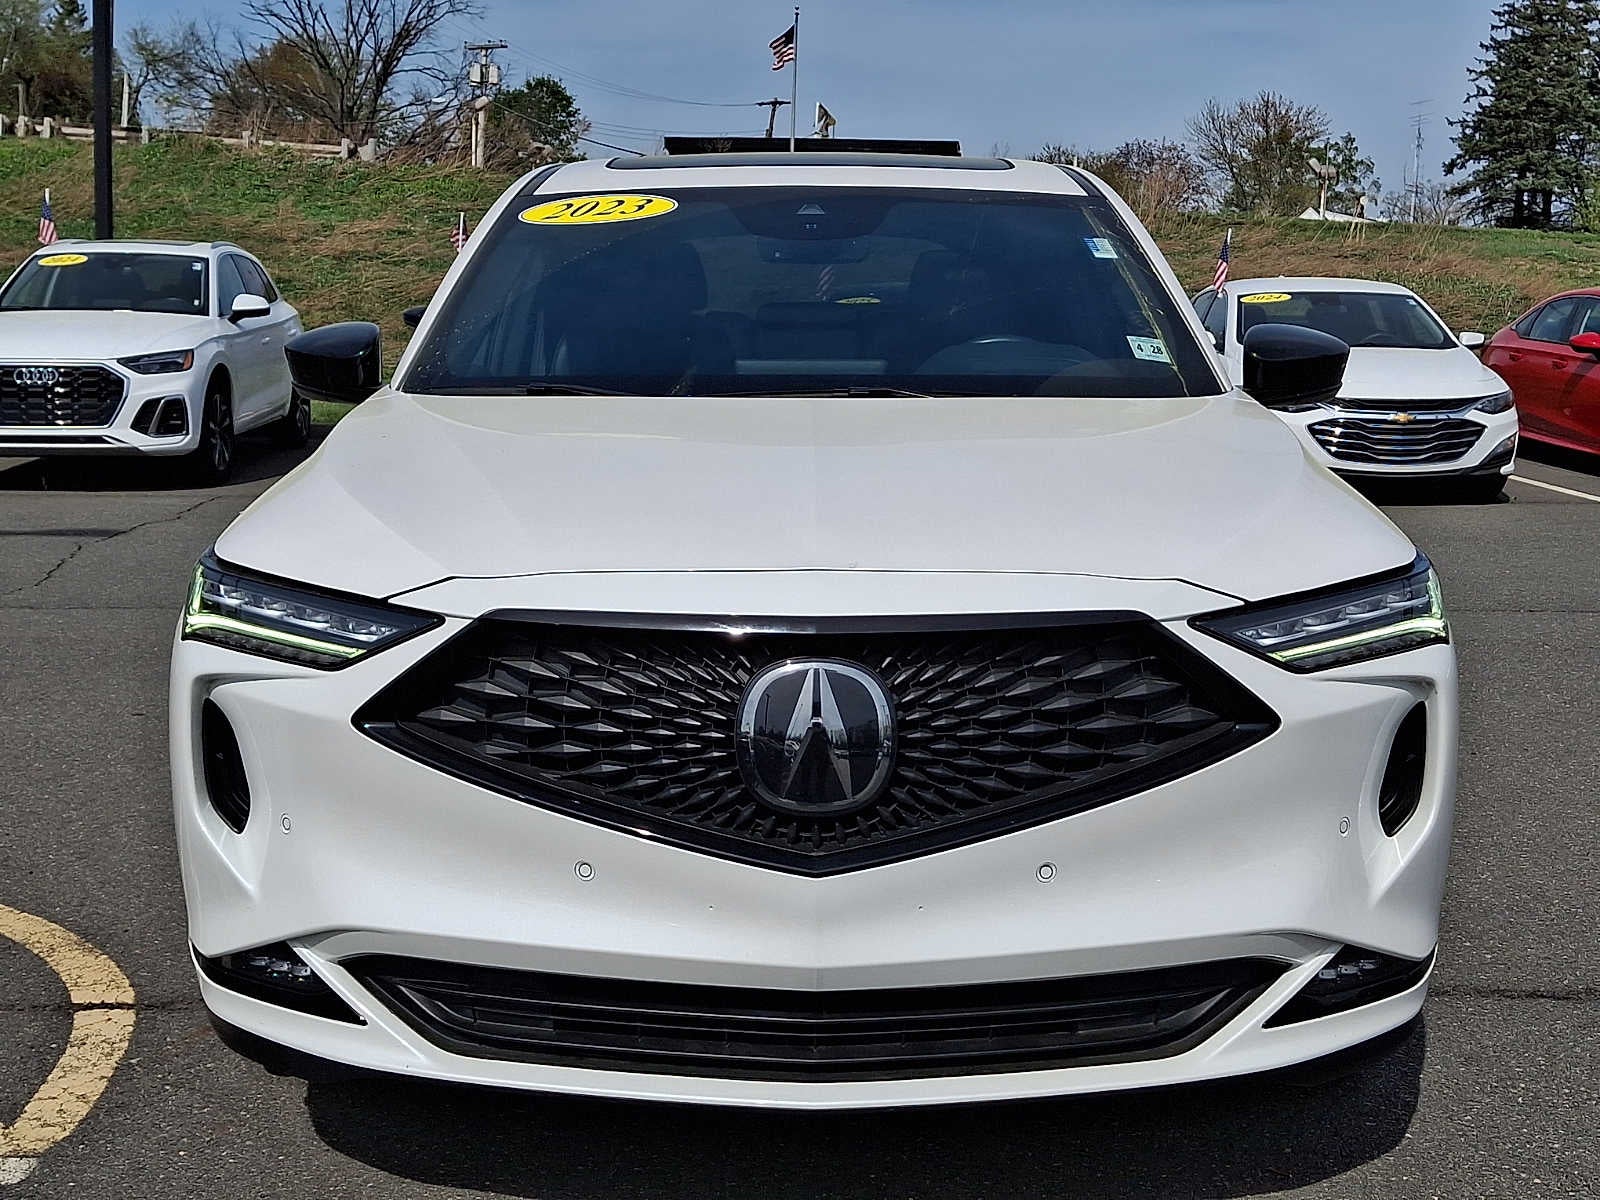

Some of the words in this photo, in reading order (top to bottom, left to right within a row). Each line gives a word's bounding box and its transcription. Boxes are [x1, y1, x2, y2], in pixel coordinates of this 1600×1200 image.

[541, 199, 653, 220] 2023
[1246, 294, 1283, 302] 2024
[1136, 343, 1144, 353] 4
[1150, 344, 1164, 355] 28
